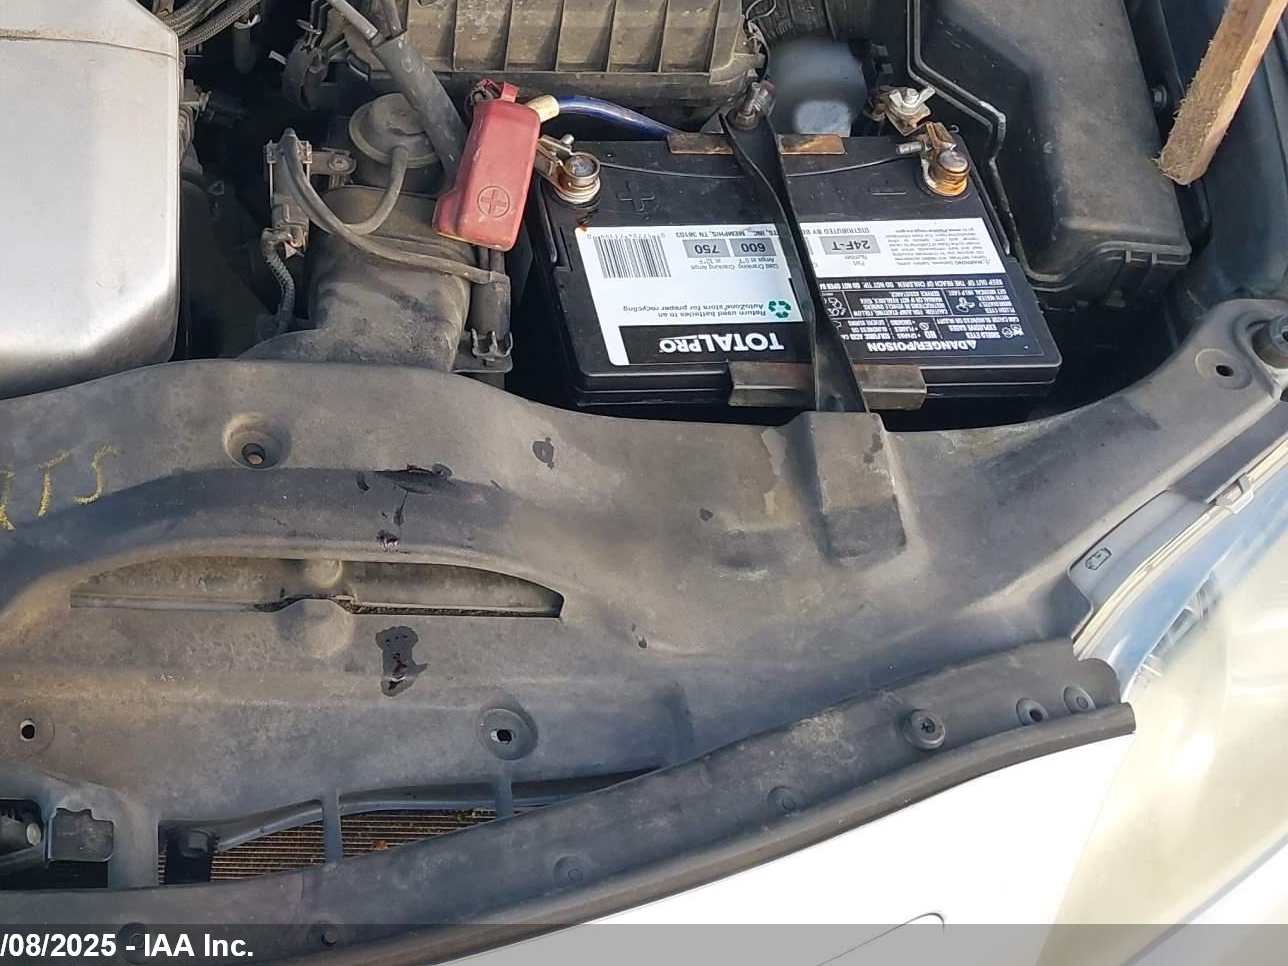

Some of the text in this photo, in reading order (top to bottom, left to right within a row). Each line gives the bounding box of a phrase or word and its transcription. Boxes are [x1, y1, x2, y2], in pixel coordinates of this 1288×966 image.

[694, 245, 720, 254] 750
[741, 243, 766, 253] 600
[832, 240, 870, 250] 24F-T
[623, 305, 659, 313] recycling
[659, 333, 785, 353] TOTALPRO
[866, 340, 969, 352] DANGER/POISON
